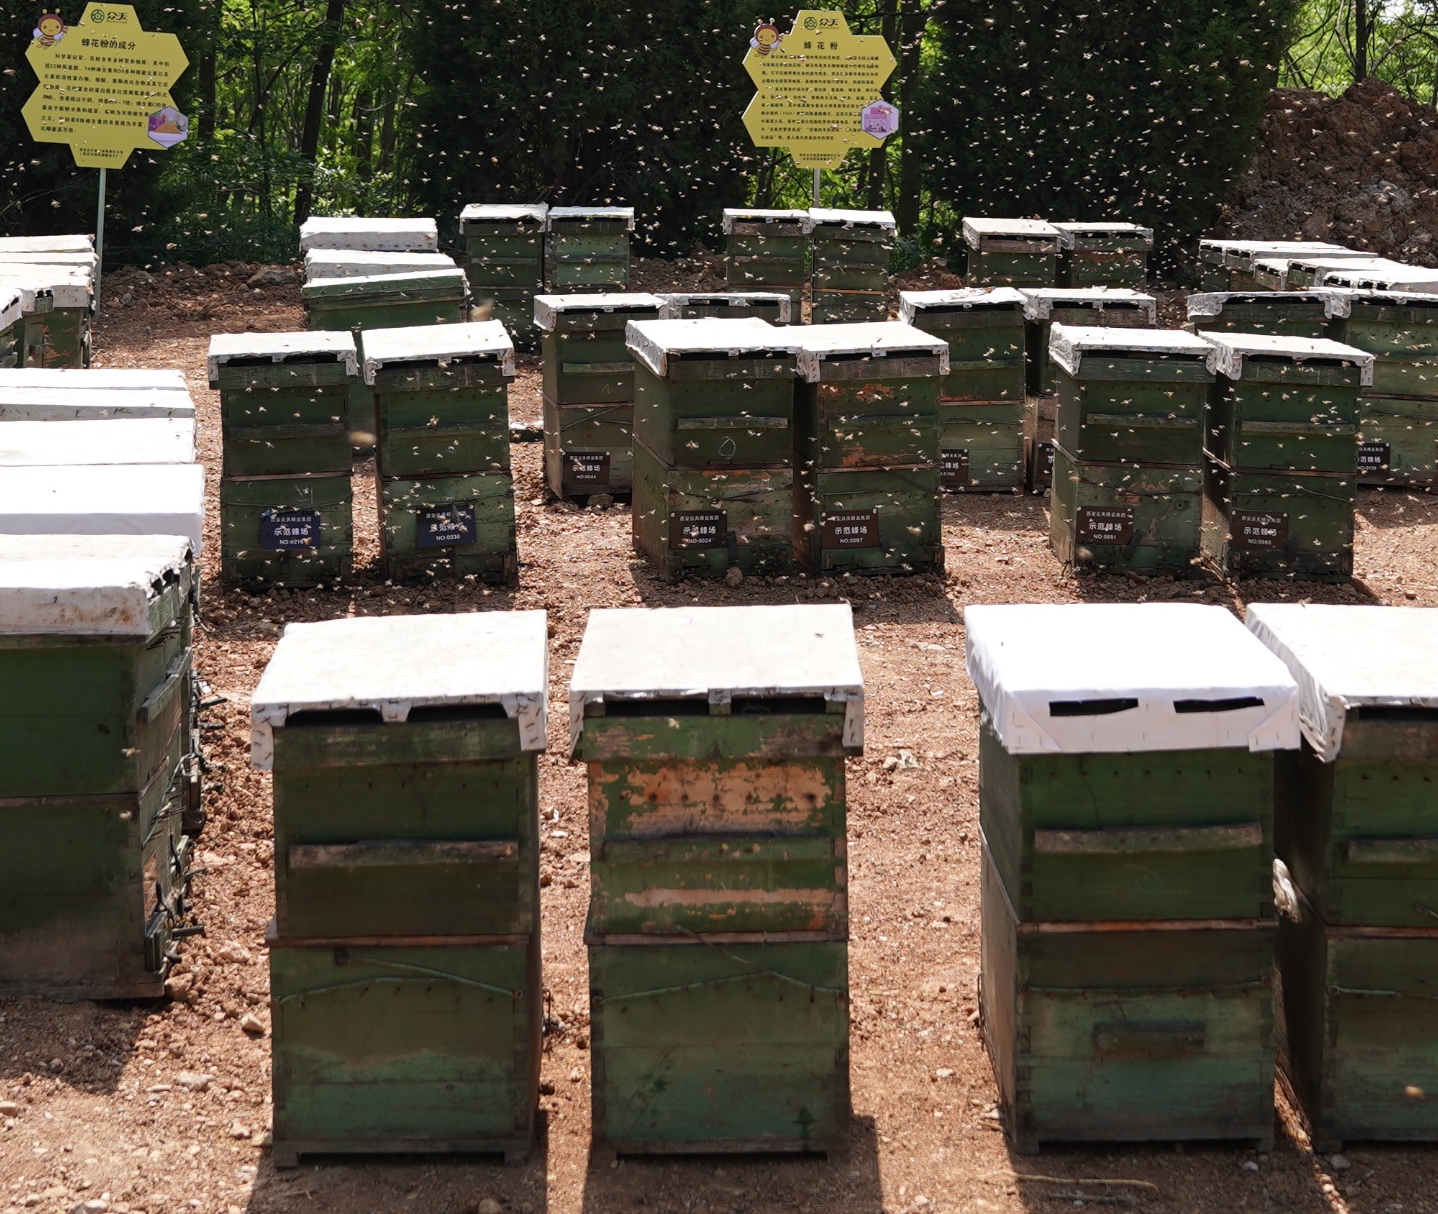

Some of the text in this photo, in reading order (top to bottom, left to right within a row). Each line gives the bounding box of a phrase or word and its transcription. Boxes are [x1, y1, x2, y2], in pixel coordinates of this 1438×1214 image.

[81, 38, 136, 50] 蜂花粉的成分
[803, 41, 838, 51] 蜂花粉
[679, 514, 720, 522] 西安众天蜂业集团
[1085, 510, 1126, 518] 西安众天蜂业集团
[683, 525, 716, 536] 示范蜂场
[834, 525, 869, 535] 示范蜂场
[1088, 522, 1123, 532] 示范蜂场
